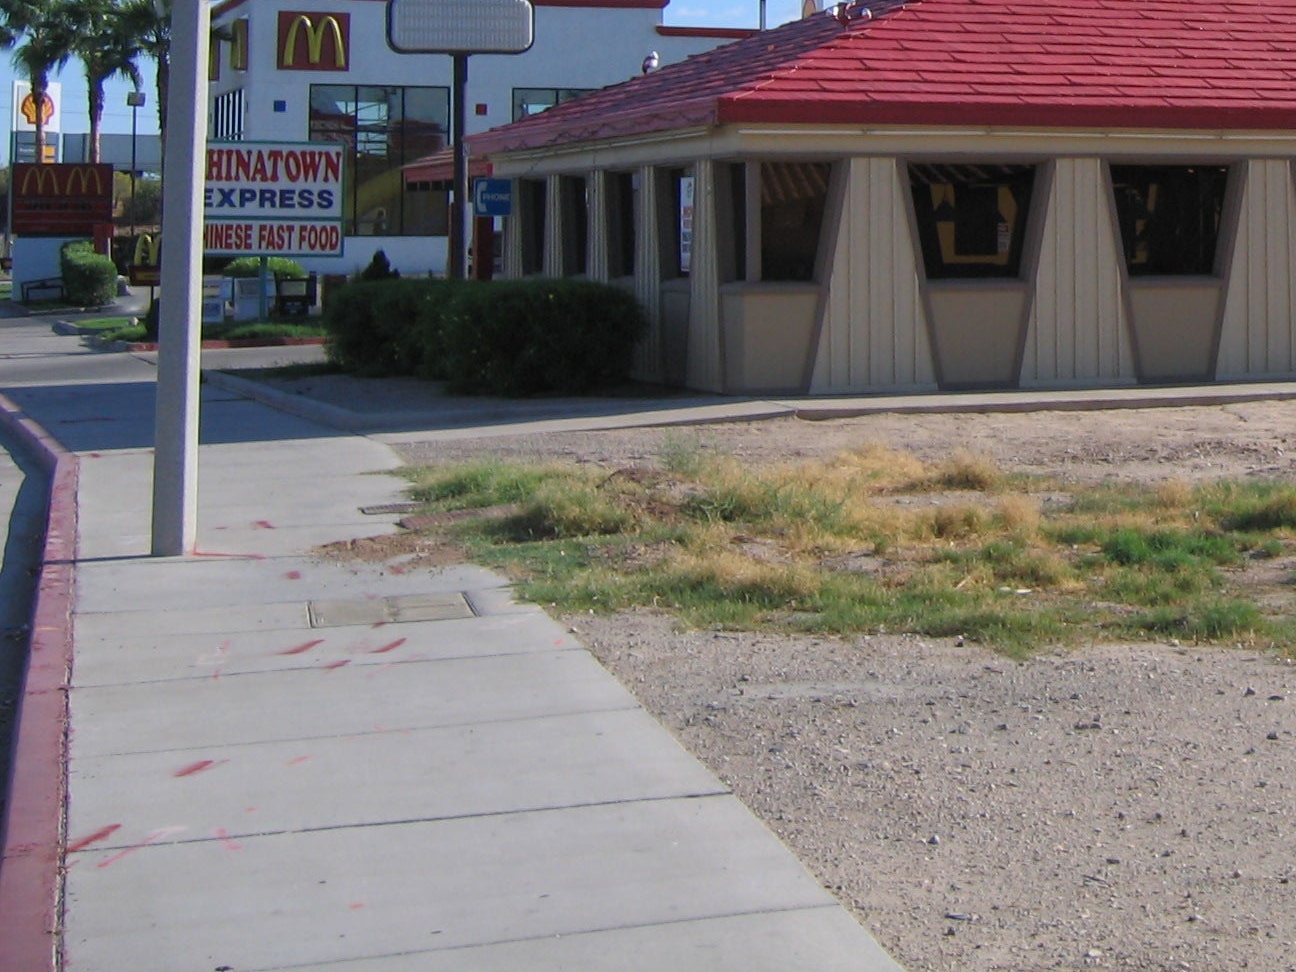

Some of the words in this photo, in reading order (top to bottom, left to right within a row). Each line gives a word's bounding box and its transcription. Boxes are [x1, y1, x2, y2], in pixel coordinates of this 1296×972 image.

[206, 148, 342, 183] HINATOWN
[203, 223, 253, 250] INESE
[258, 224, 294, 250] FAST
[299, 225, 339, 251] FOOD
